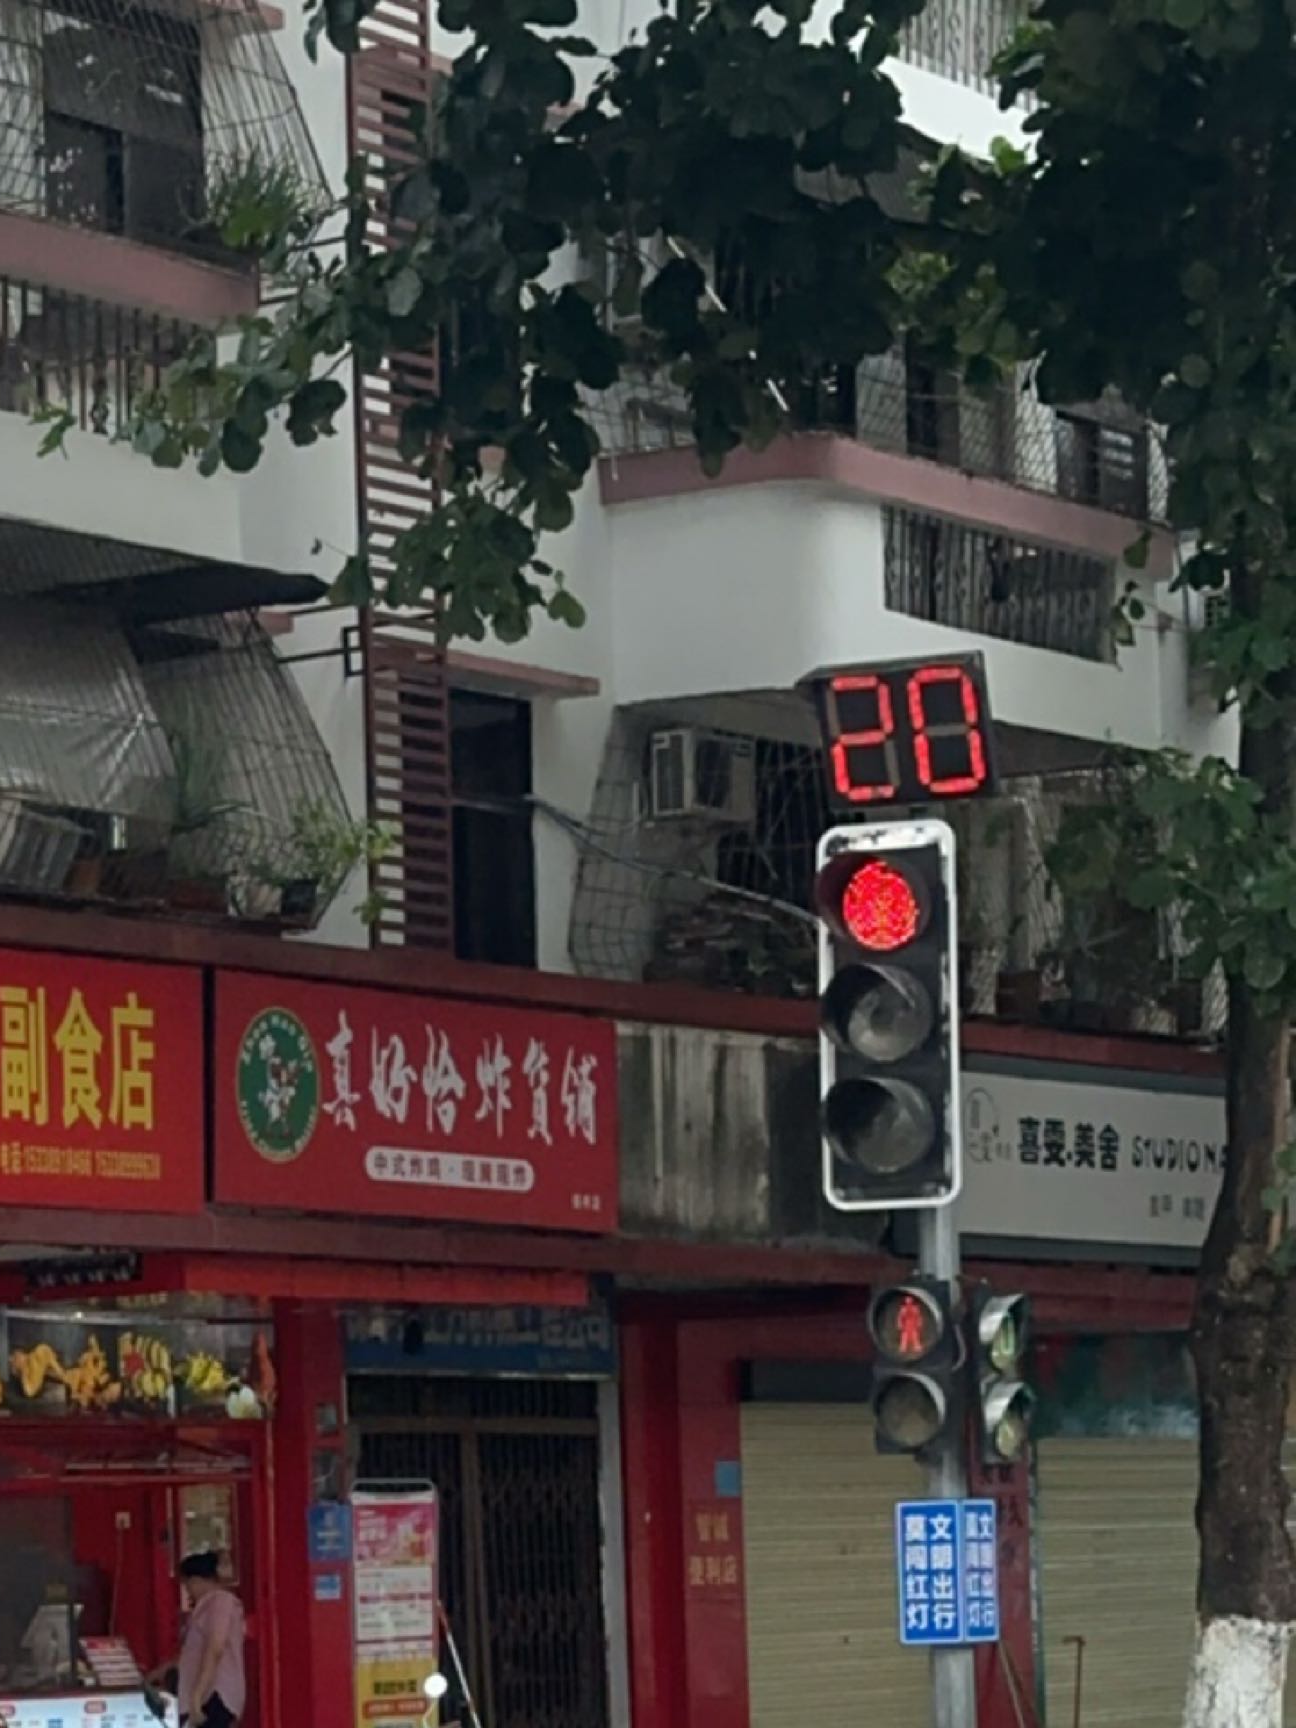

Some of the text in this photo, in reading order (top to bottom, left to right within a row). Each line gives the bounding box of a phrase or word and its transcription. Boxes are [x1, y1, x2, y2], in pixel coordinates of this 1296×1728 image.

[830, 665, 986, 802] 20
[929, 1513, 956, 1631] 文明出行
